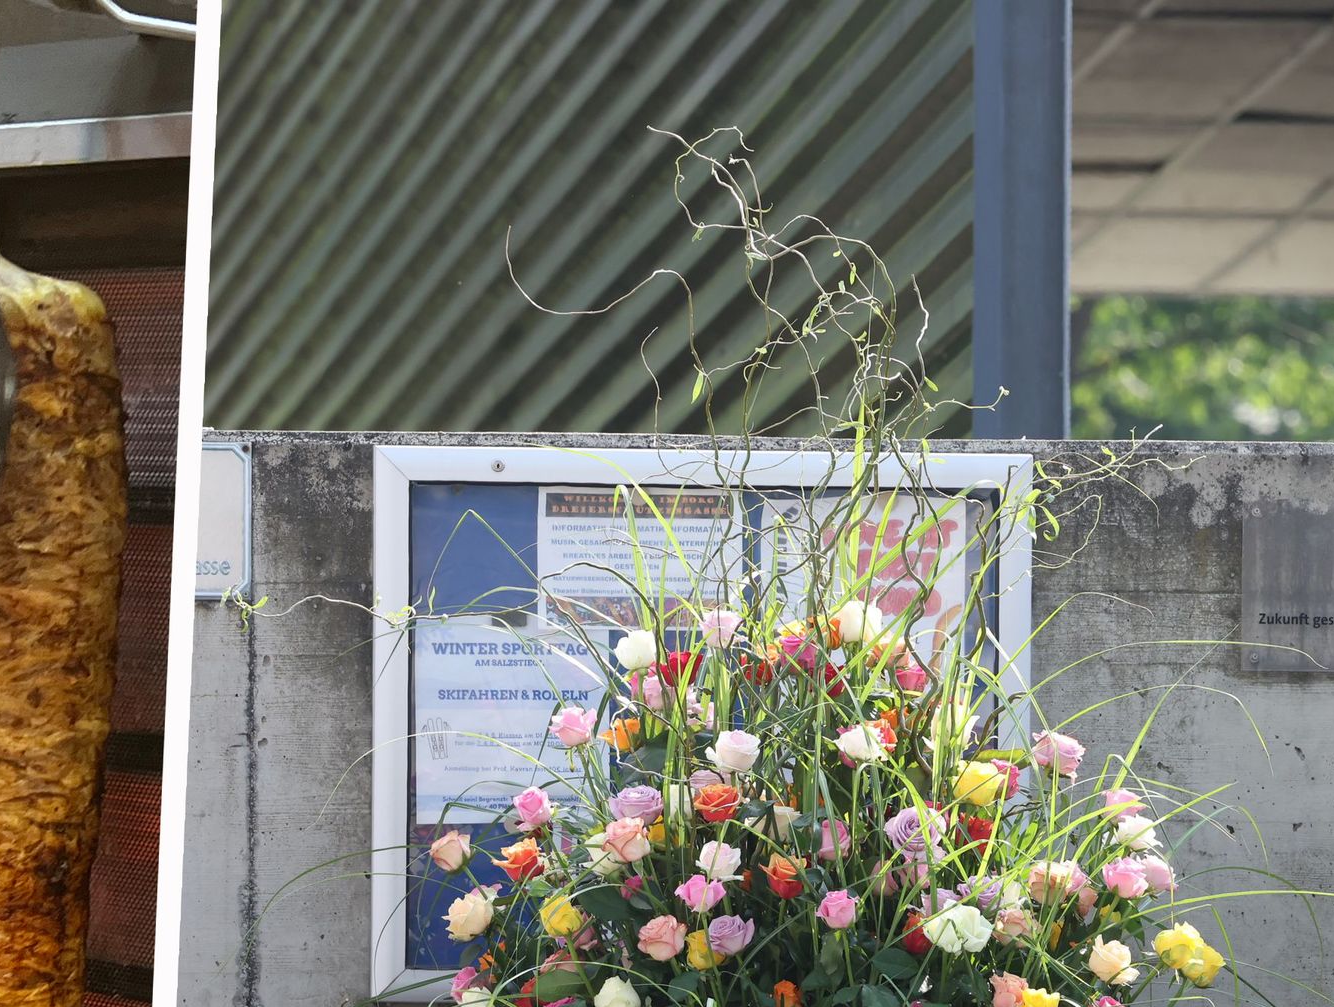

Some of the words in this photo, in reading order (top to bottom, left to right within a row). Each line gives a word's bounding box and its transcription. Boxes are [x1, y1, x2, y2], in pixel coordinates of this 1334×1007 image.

[1259, 612, 1309, 625] Zukunft
[432, 643, 498, 655] WINTER
[475, 659, 490, 667] AM
[438, 690, 517, 700] SKIFAHREN
[521, 690, 528, 700] &
